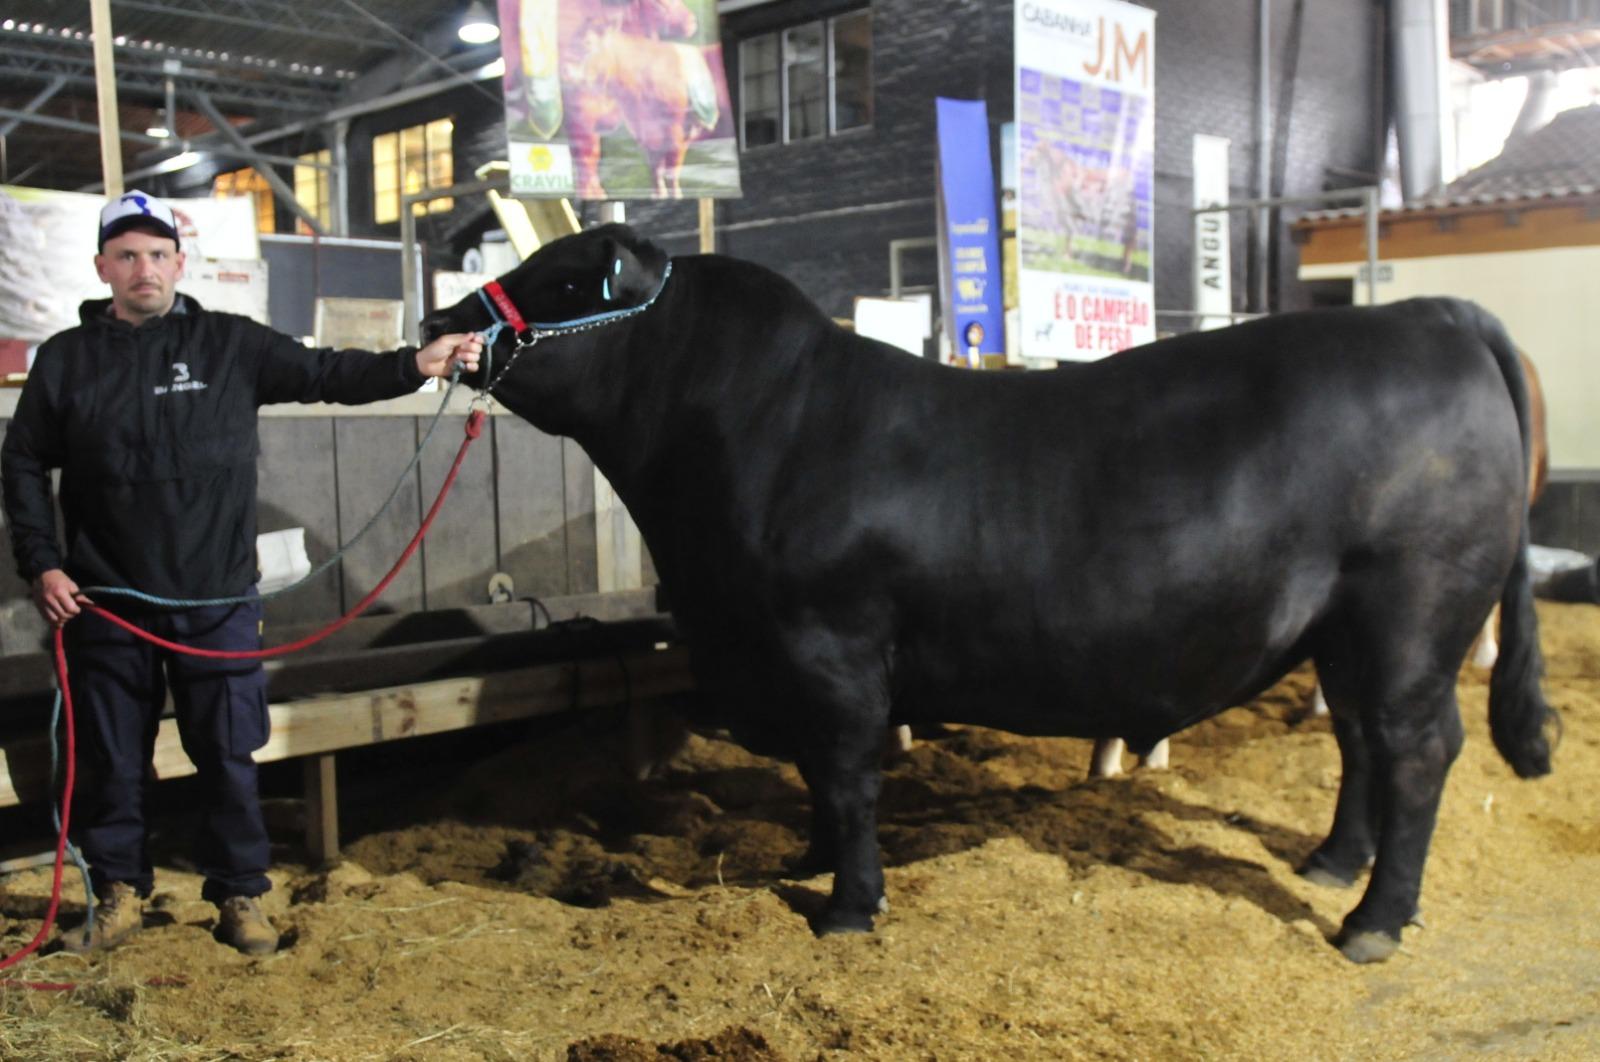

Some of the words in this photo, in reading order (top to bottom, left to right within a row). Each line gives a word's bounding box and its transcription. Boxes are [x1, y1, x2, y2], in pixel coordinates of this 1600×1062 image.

[1082, 15, 1149, 89] J.M
[1066, 293, 1077, 321] O
[1075, 323, 1093, 350] DE
[1098, 325, 1133, 354] PESO
